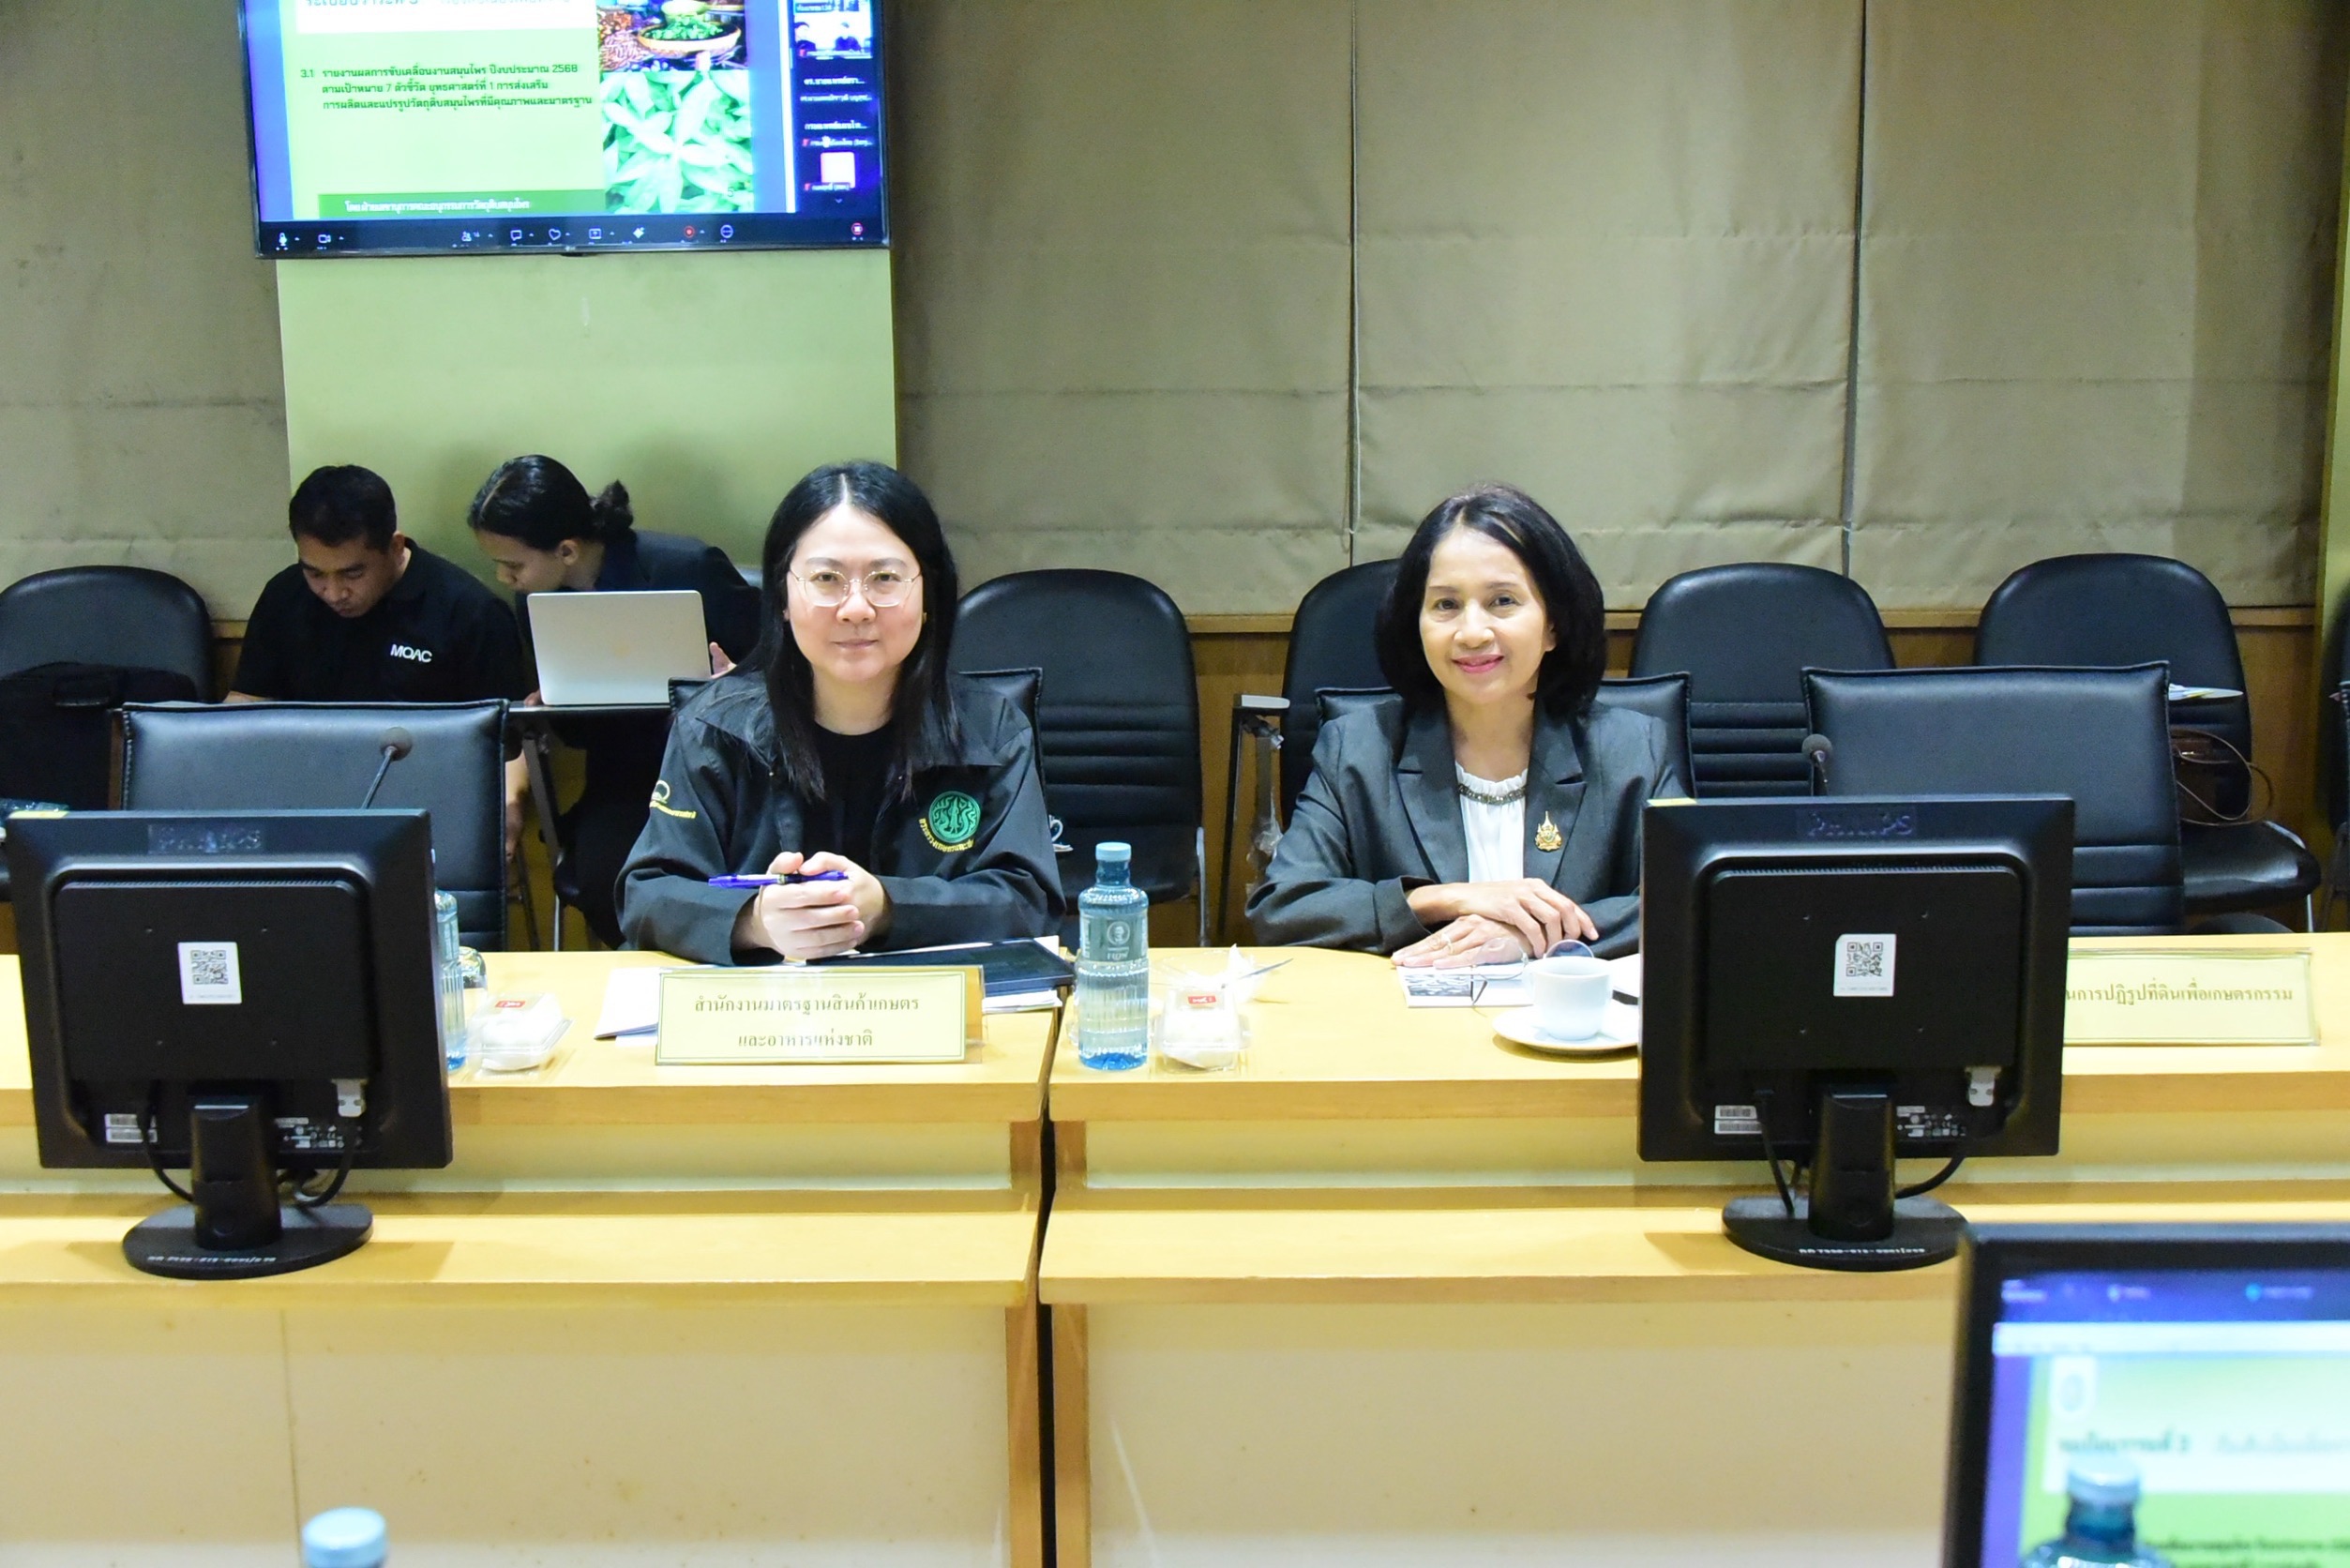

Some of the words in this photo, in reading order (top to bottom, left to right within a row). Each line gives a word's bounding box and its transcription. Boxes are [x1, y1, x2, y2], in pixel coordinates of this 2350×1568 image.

[300, 68, 315, 78] 3.1
[489, 64, 550, 75] ปีงบประมาณ
[551, 64, 579, 73] 2568
[322, 83, 384, 94] ตามเป้าหมาย
[385, 83, 392, 93] 7
[496, 79, 549, 90] การส่งเสริม
[390, 643, 433, 663] MOAC
[694, 991, 920, 1016] สำนักงานมาตรฐานสินค้าเกษตร
[737, 1028, 874, 1048] และอาหารแห่งชาติ
